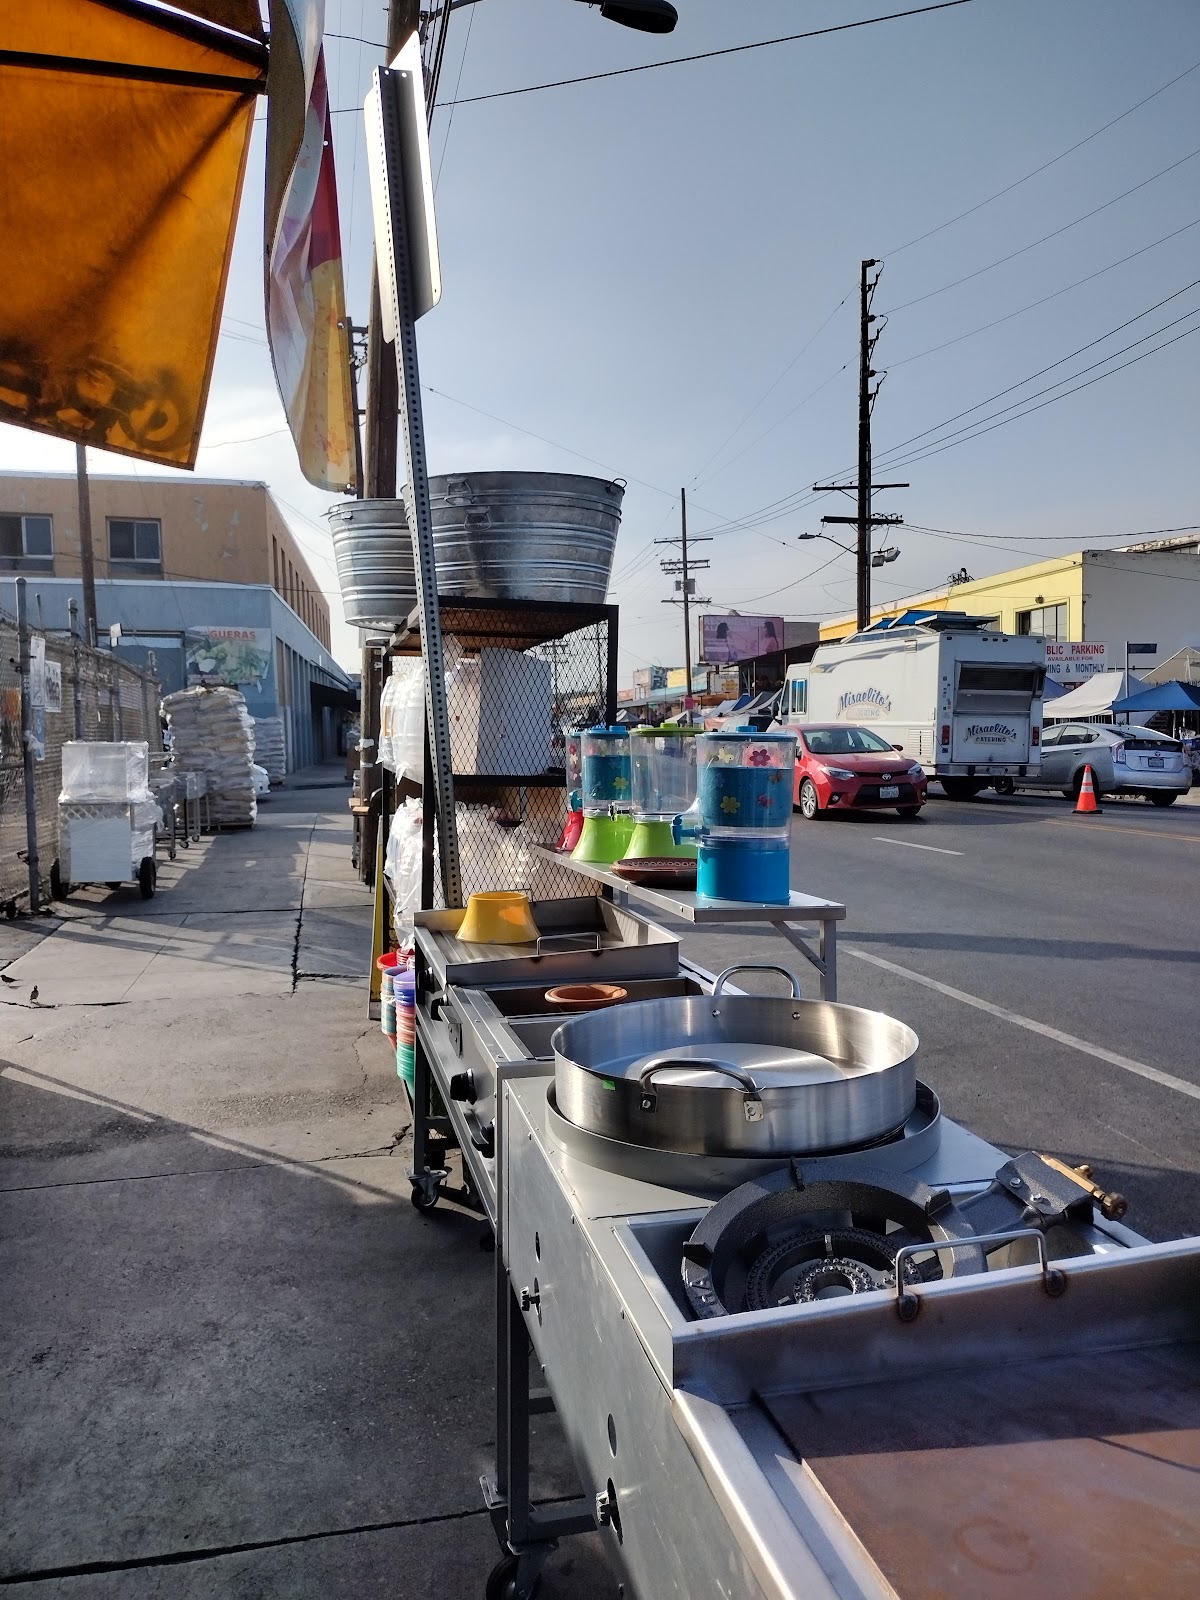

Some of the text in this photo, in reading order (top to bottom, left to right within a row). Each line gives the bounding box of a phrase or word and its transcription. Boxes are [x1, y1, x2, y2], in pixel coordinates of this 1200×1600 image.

[1071, 644, 1105, 655] PARKING
[1065, 663, 1071, 674] &
[1075, 663, 1105, 673] MONTHLY
[837, 687, 892, 717] Misaelito's
[965, 722, 1018, 741] Misaelito's
